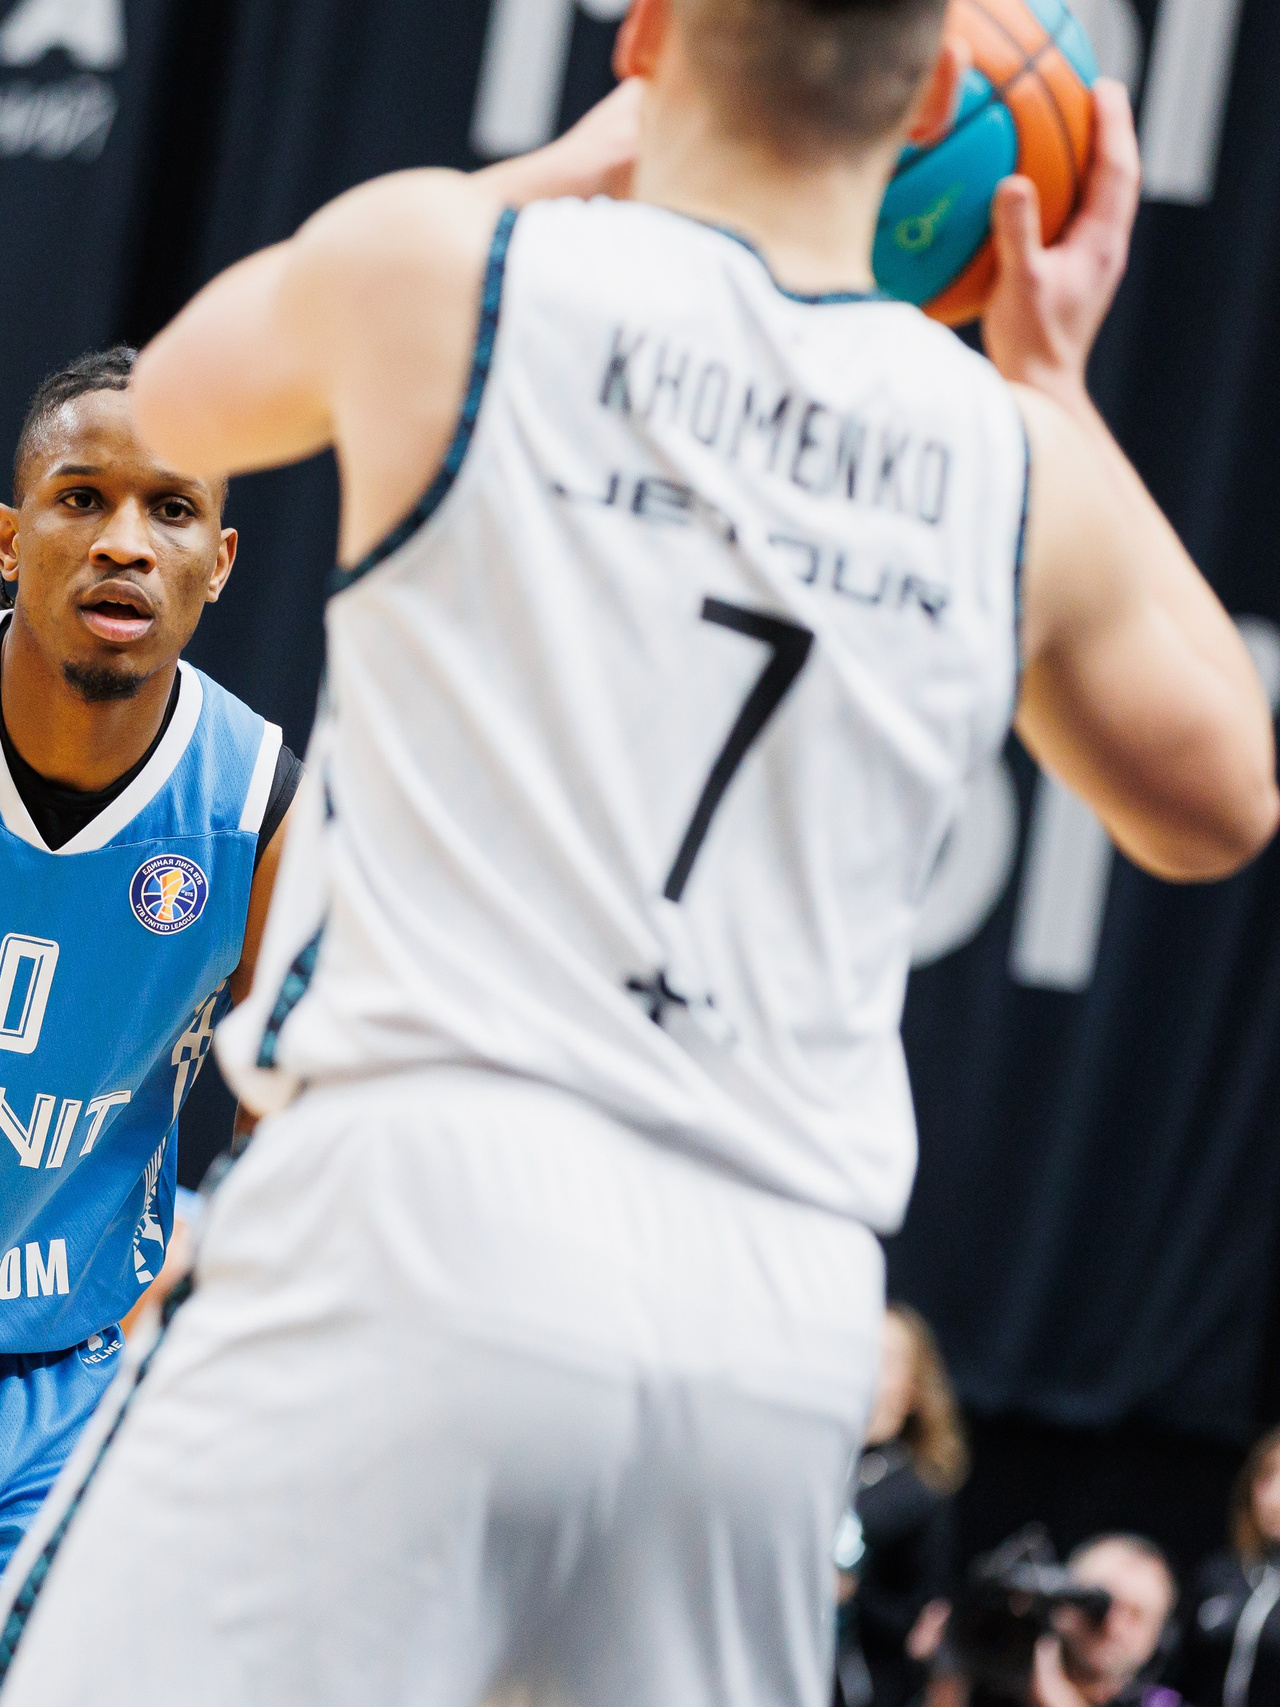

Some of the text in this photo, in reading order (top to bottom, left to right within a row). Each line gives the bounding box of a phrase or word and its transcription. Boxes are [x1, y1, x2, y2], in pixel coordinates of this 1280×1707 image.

[600, 326, 950, 526] KHOMENKO
[663, 595, 816, 904] 7
[142, 858, 174, 876] ЕДИНАЯ
[175, 859, 194, 873] ЛИГА
[135, 903, 196, 931] VTB UNITED LEAGUE
[82, 1340, 123, 1364] KELME
